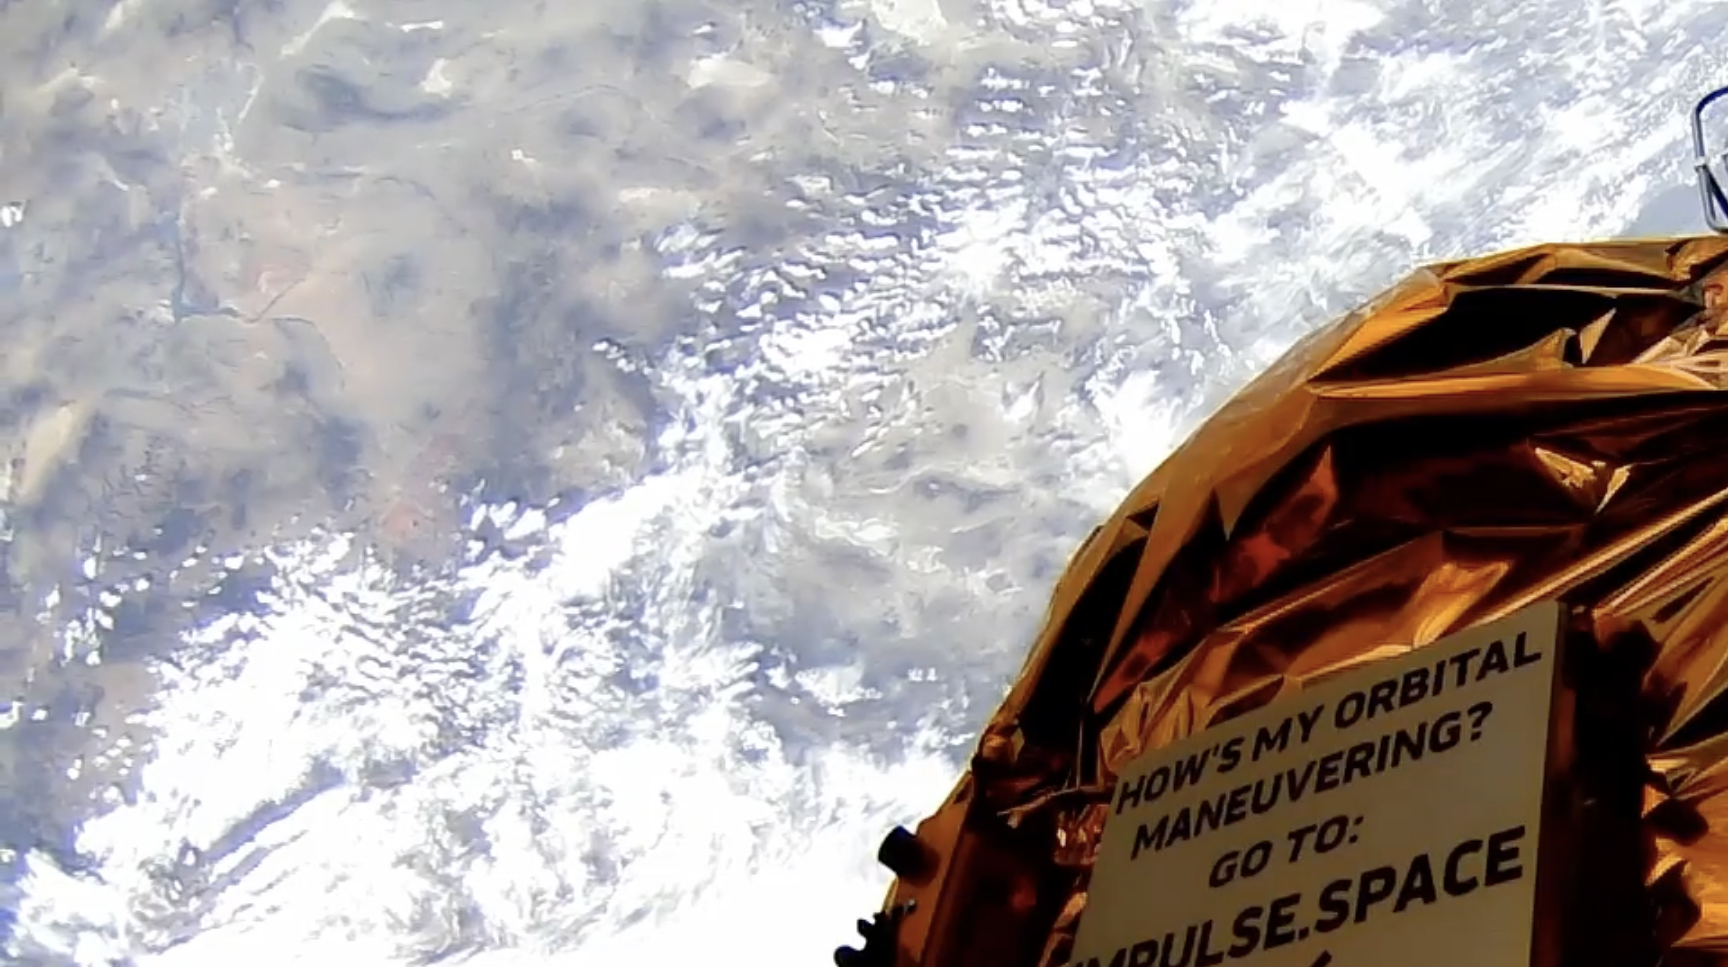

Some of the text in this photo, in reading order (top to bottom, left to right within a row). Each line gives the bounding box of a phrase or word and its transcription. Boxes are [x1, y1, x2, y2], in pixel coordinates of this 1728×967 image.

[1115, 631, 1542, 815] HOW'S MY ORBITAL
[1131, 701, 1494, 861] MANEUVERING?
[1209, 814, 1364, 889] GO TO:
